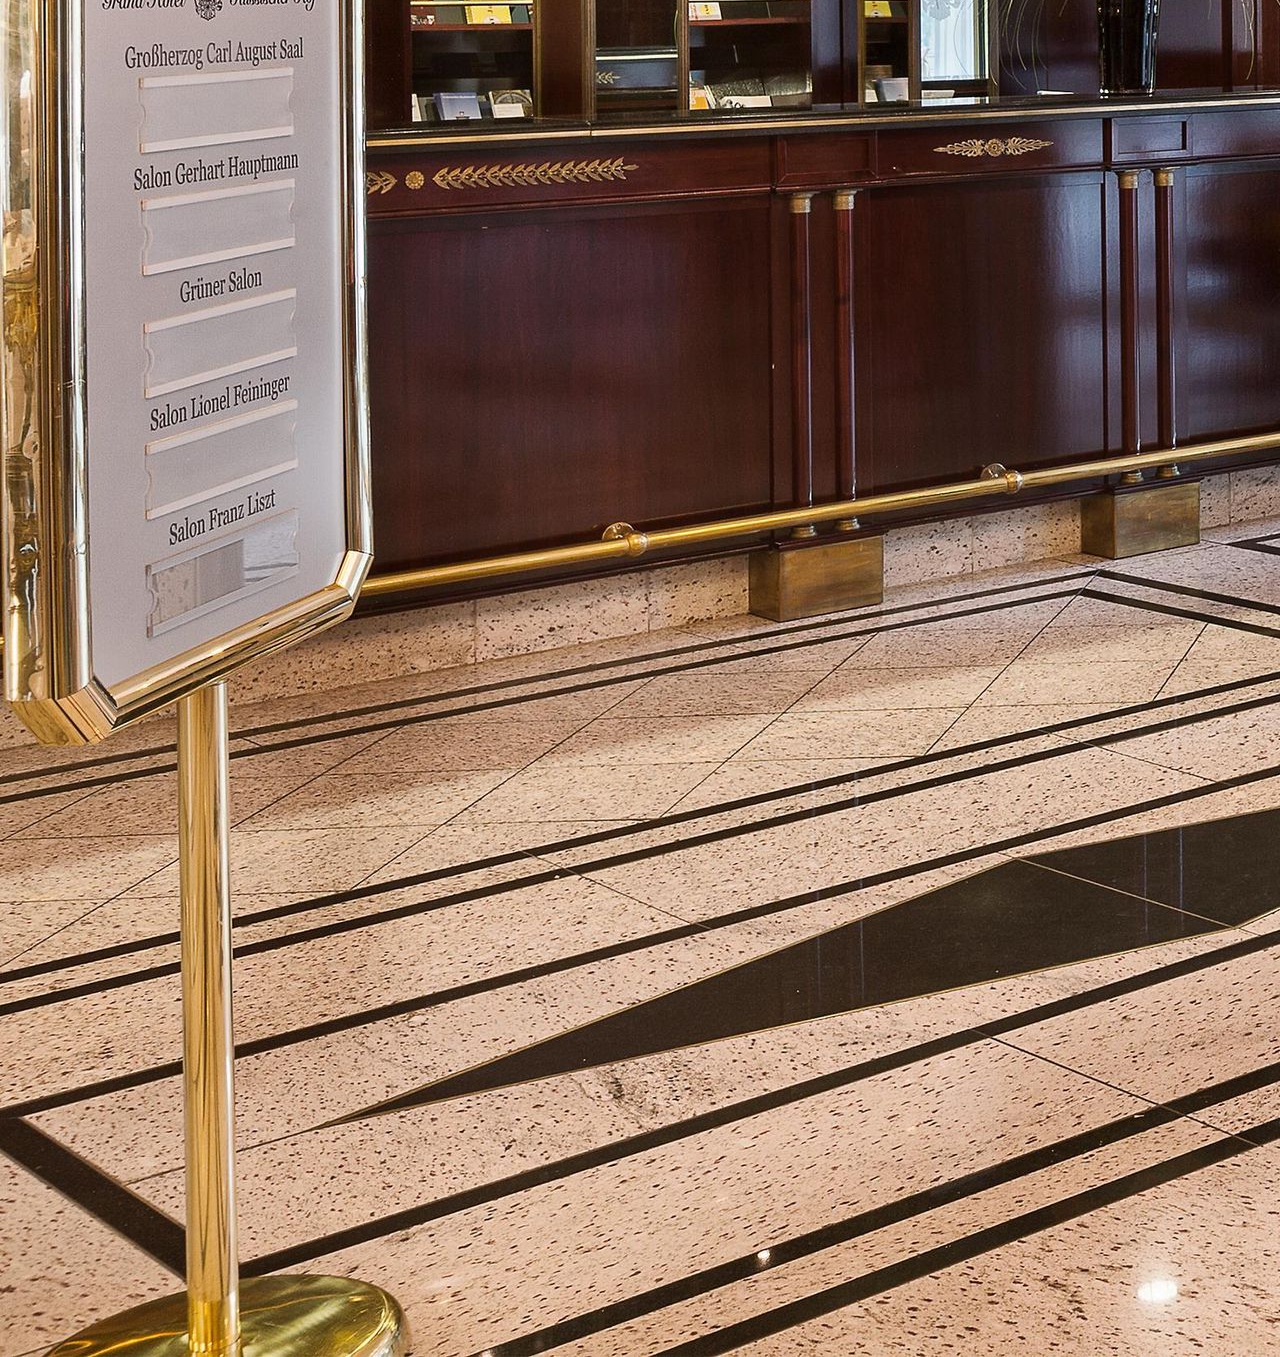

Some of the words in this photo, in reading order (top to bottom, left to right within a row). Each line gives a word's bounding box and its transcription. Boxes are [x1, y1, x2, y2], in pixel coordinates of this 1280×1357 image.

[125, 43, 204, 70] Großherzog
[206, 40, 232, 64] Carl
[236, 40, 278, 66] August
[279, 37, 304, 59] Saal
[133, 165, 172, 190] Salon
[175, 159, 225, 185] Gerhart
[228, 153, 299, 180] Hauptmann
[180, 277, 226, 303] Grüner
[228, 268, 263, 293] Salon
[150, 403, 187, 431] Salon
[190, 387, 231, 419] Lionel
[233, 376, 290, 406] Feininger
[169, 517, 206, 546] Salon
[209, 503, 245, 531] Franz
[247, 489, 276, 516] Liszt
